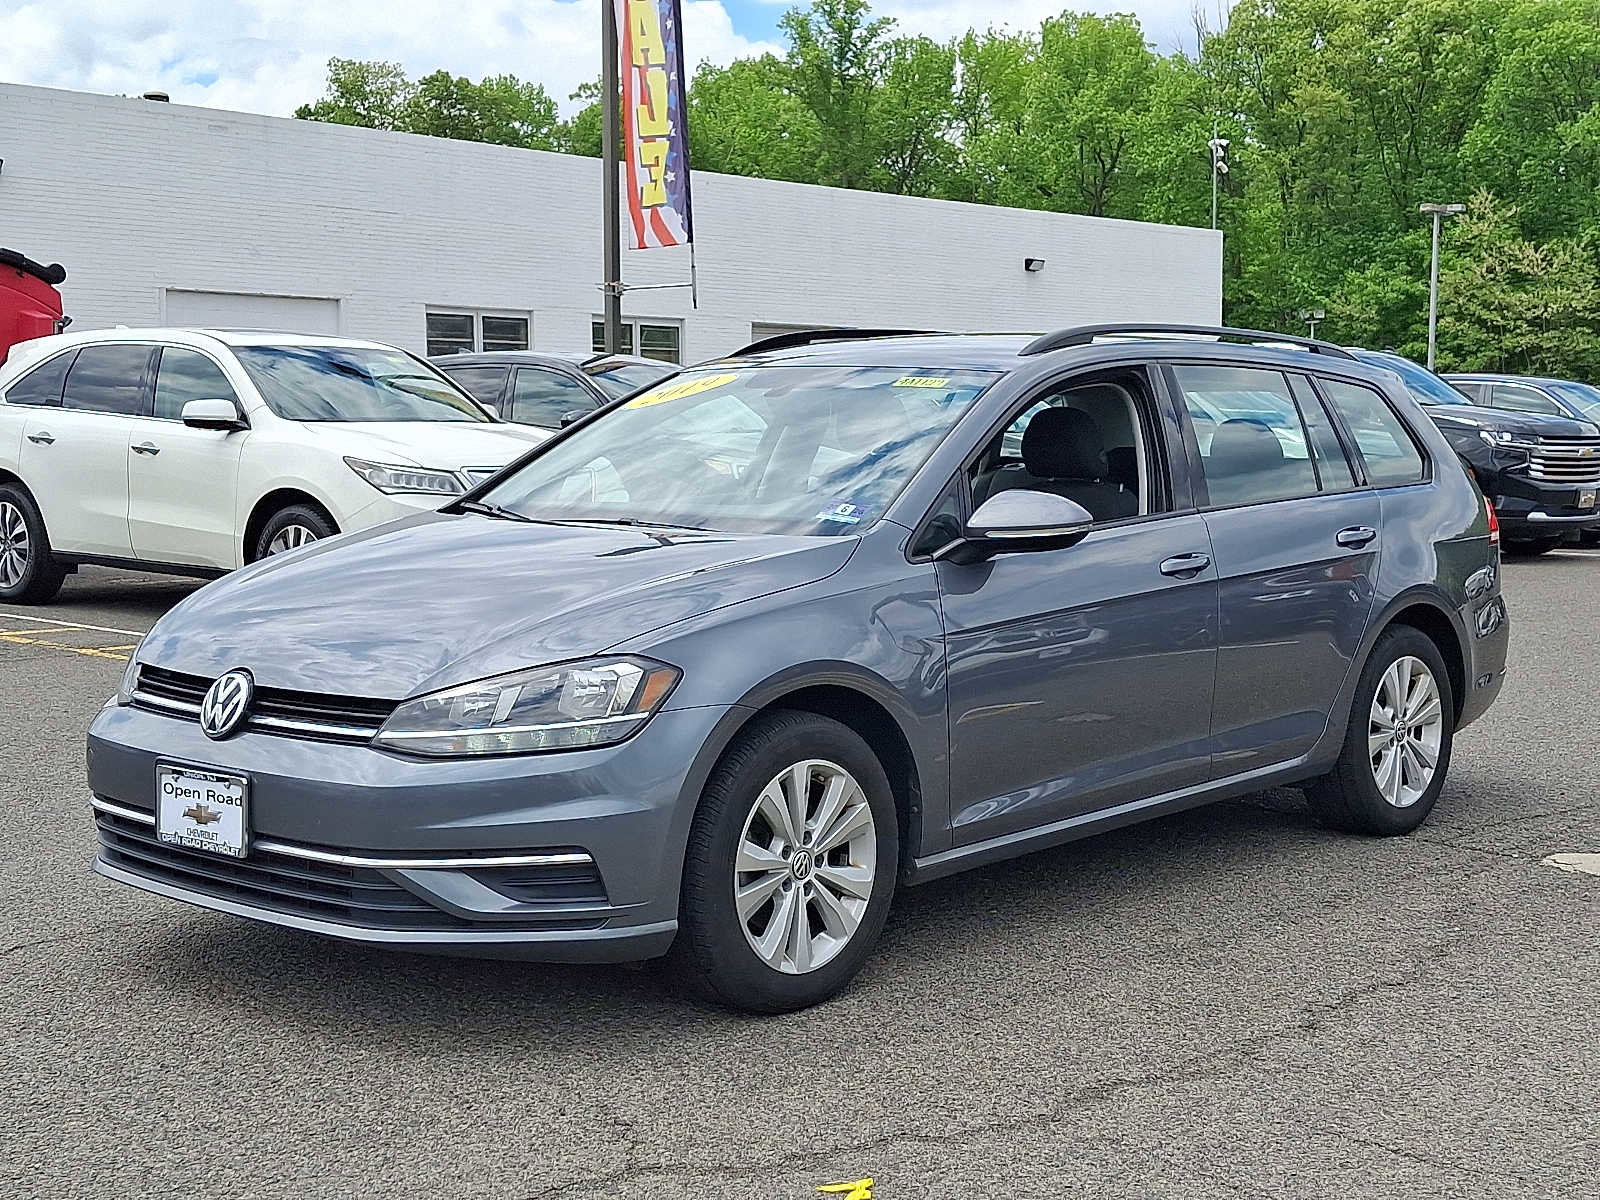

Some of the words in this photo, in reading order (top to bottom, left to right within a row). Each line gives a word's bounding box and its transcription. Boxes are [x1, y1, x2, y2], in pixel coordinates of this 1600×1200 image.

[163, 782, 201, 799] Open
[206, 789, 243, 807] Road
[161, 833, 181, 845] OPEN
[182, 837, 201, 849] ROAD
[202, 841, 240, 856] CHEVROLET
